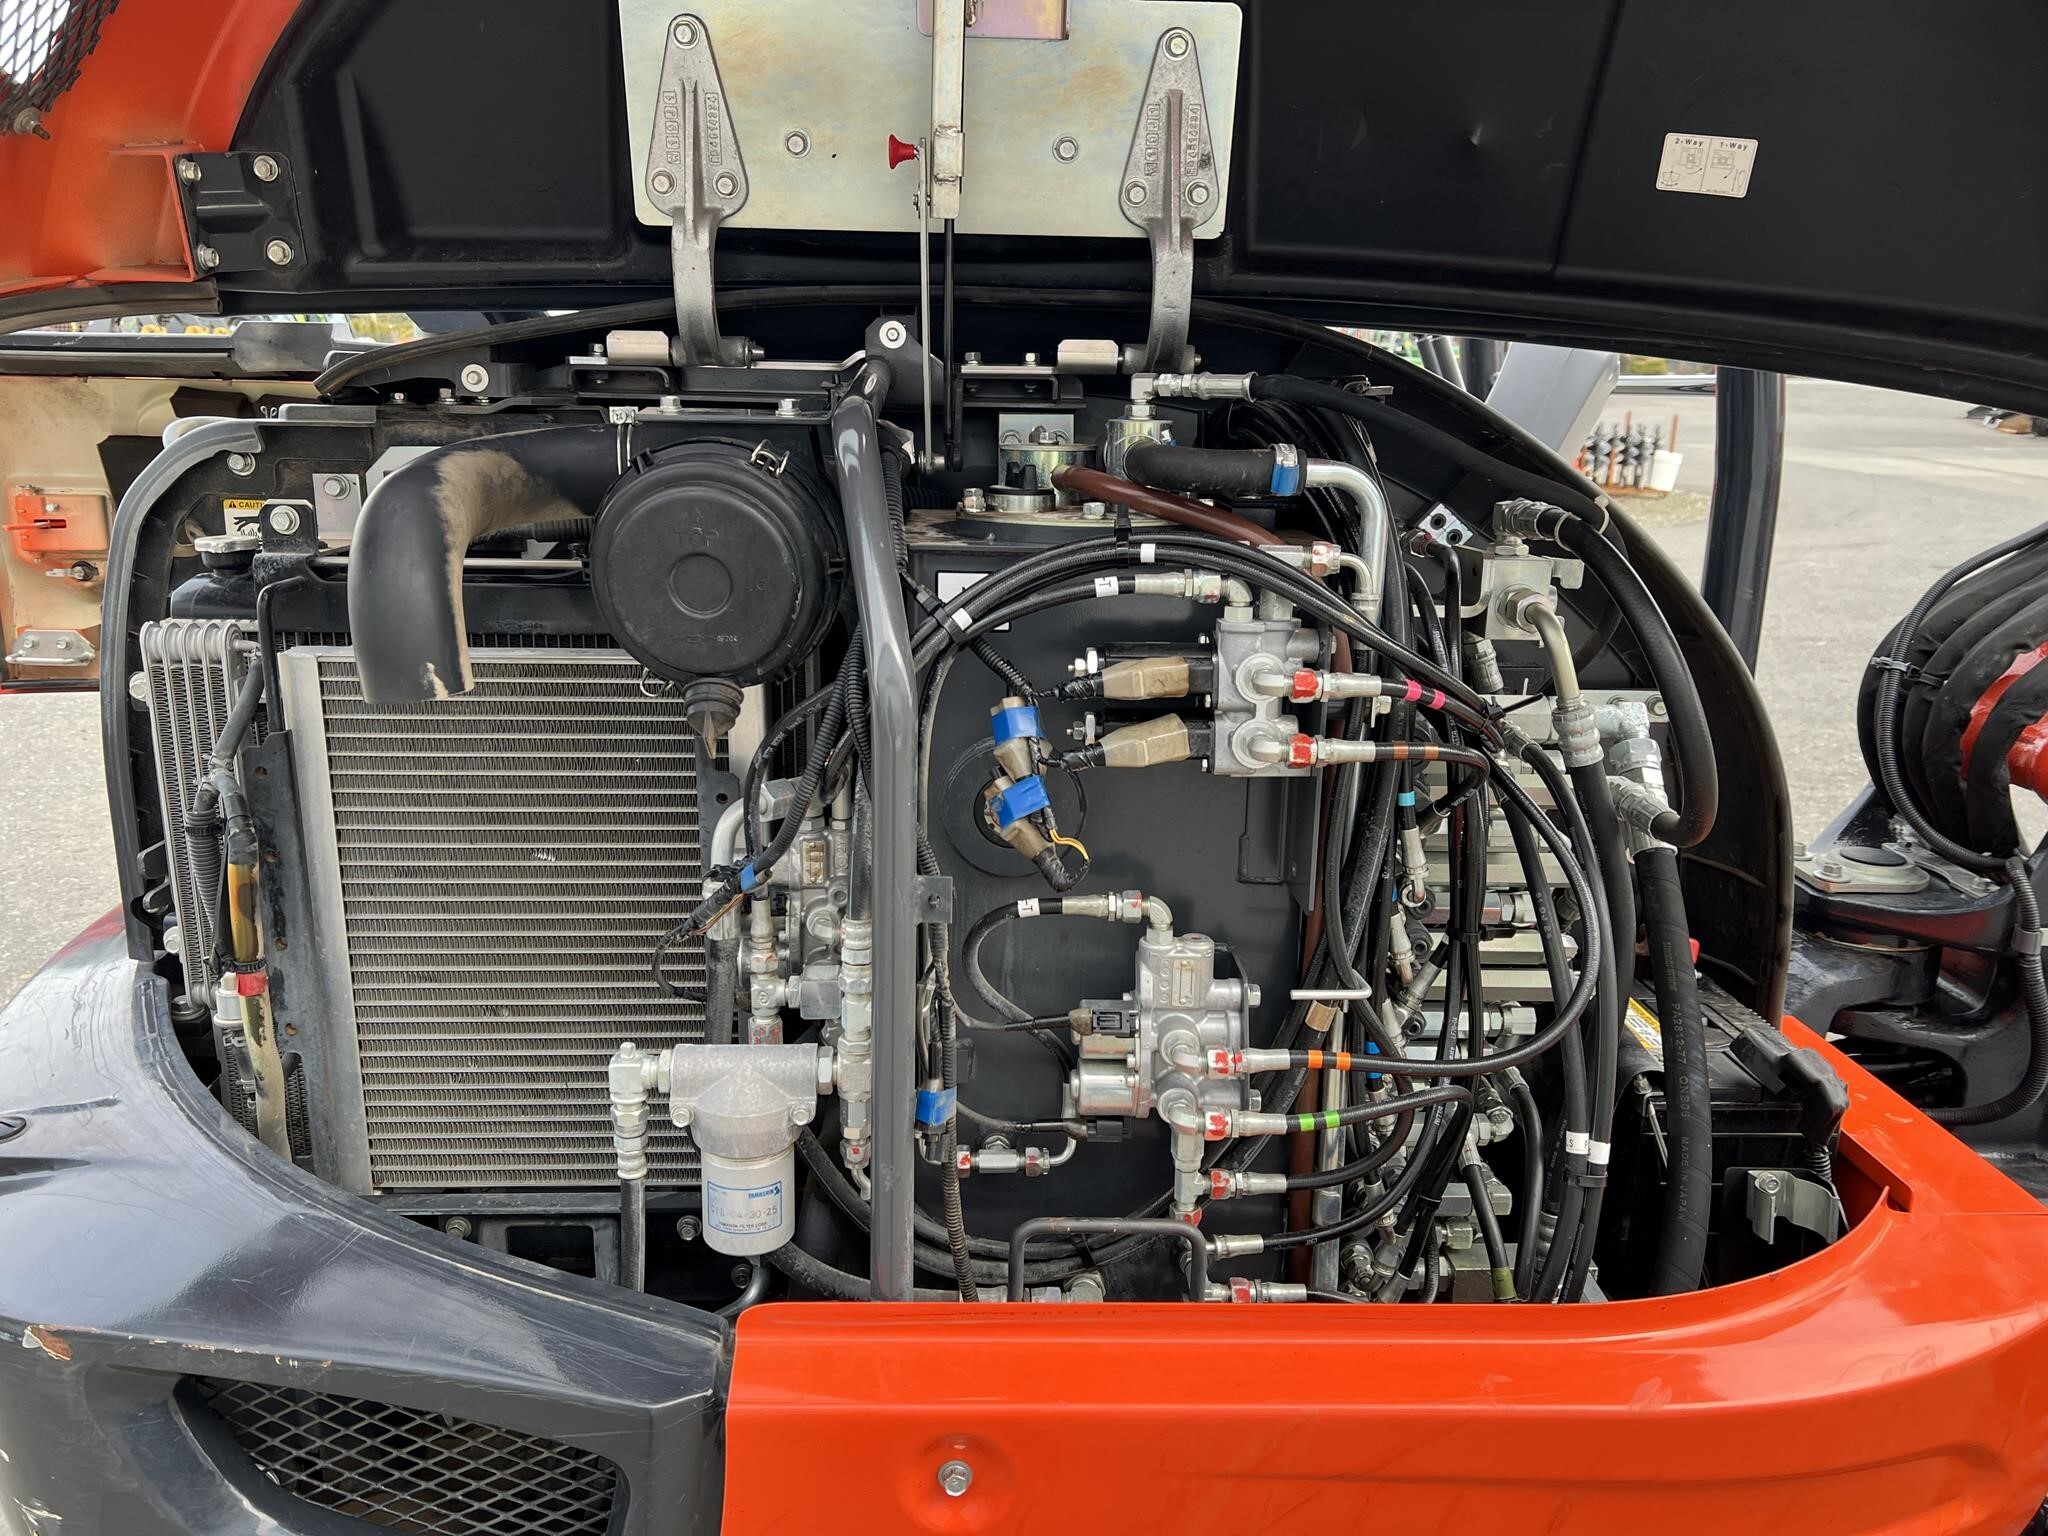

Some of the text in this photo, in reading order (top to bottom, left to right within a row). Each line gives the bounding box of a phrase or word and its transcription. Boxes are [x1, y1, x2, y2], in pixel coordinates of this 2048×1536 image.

[1674, 137, 1704, 148] 2-Way
[1719, 141, 1748, 152] 1-Way
[1681, 1136, 1689, 1167] MADE
[1677, 1188, 1688, 1220] JAPAN
